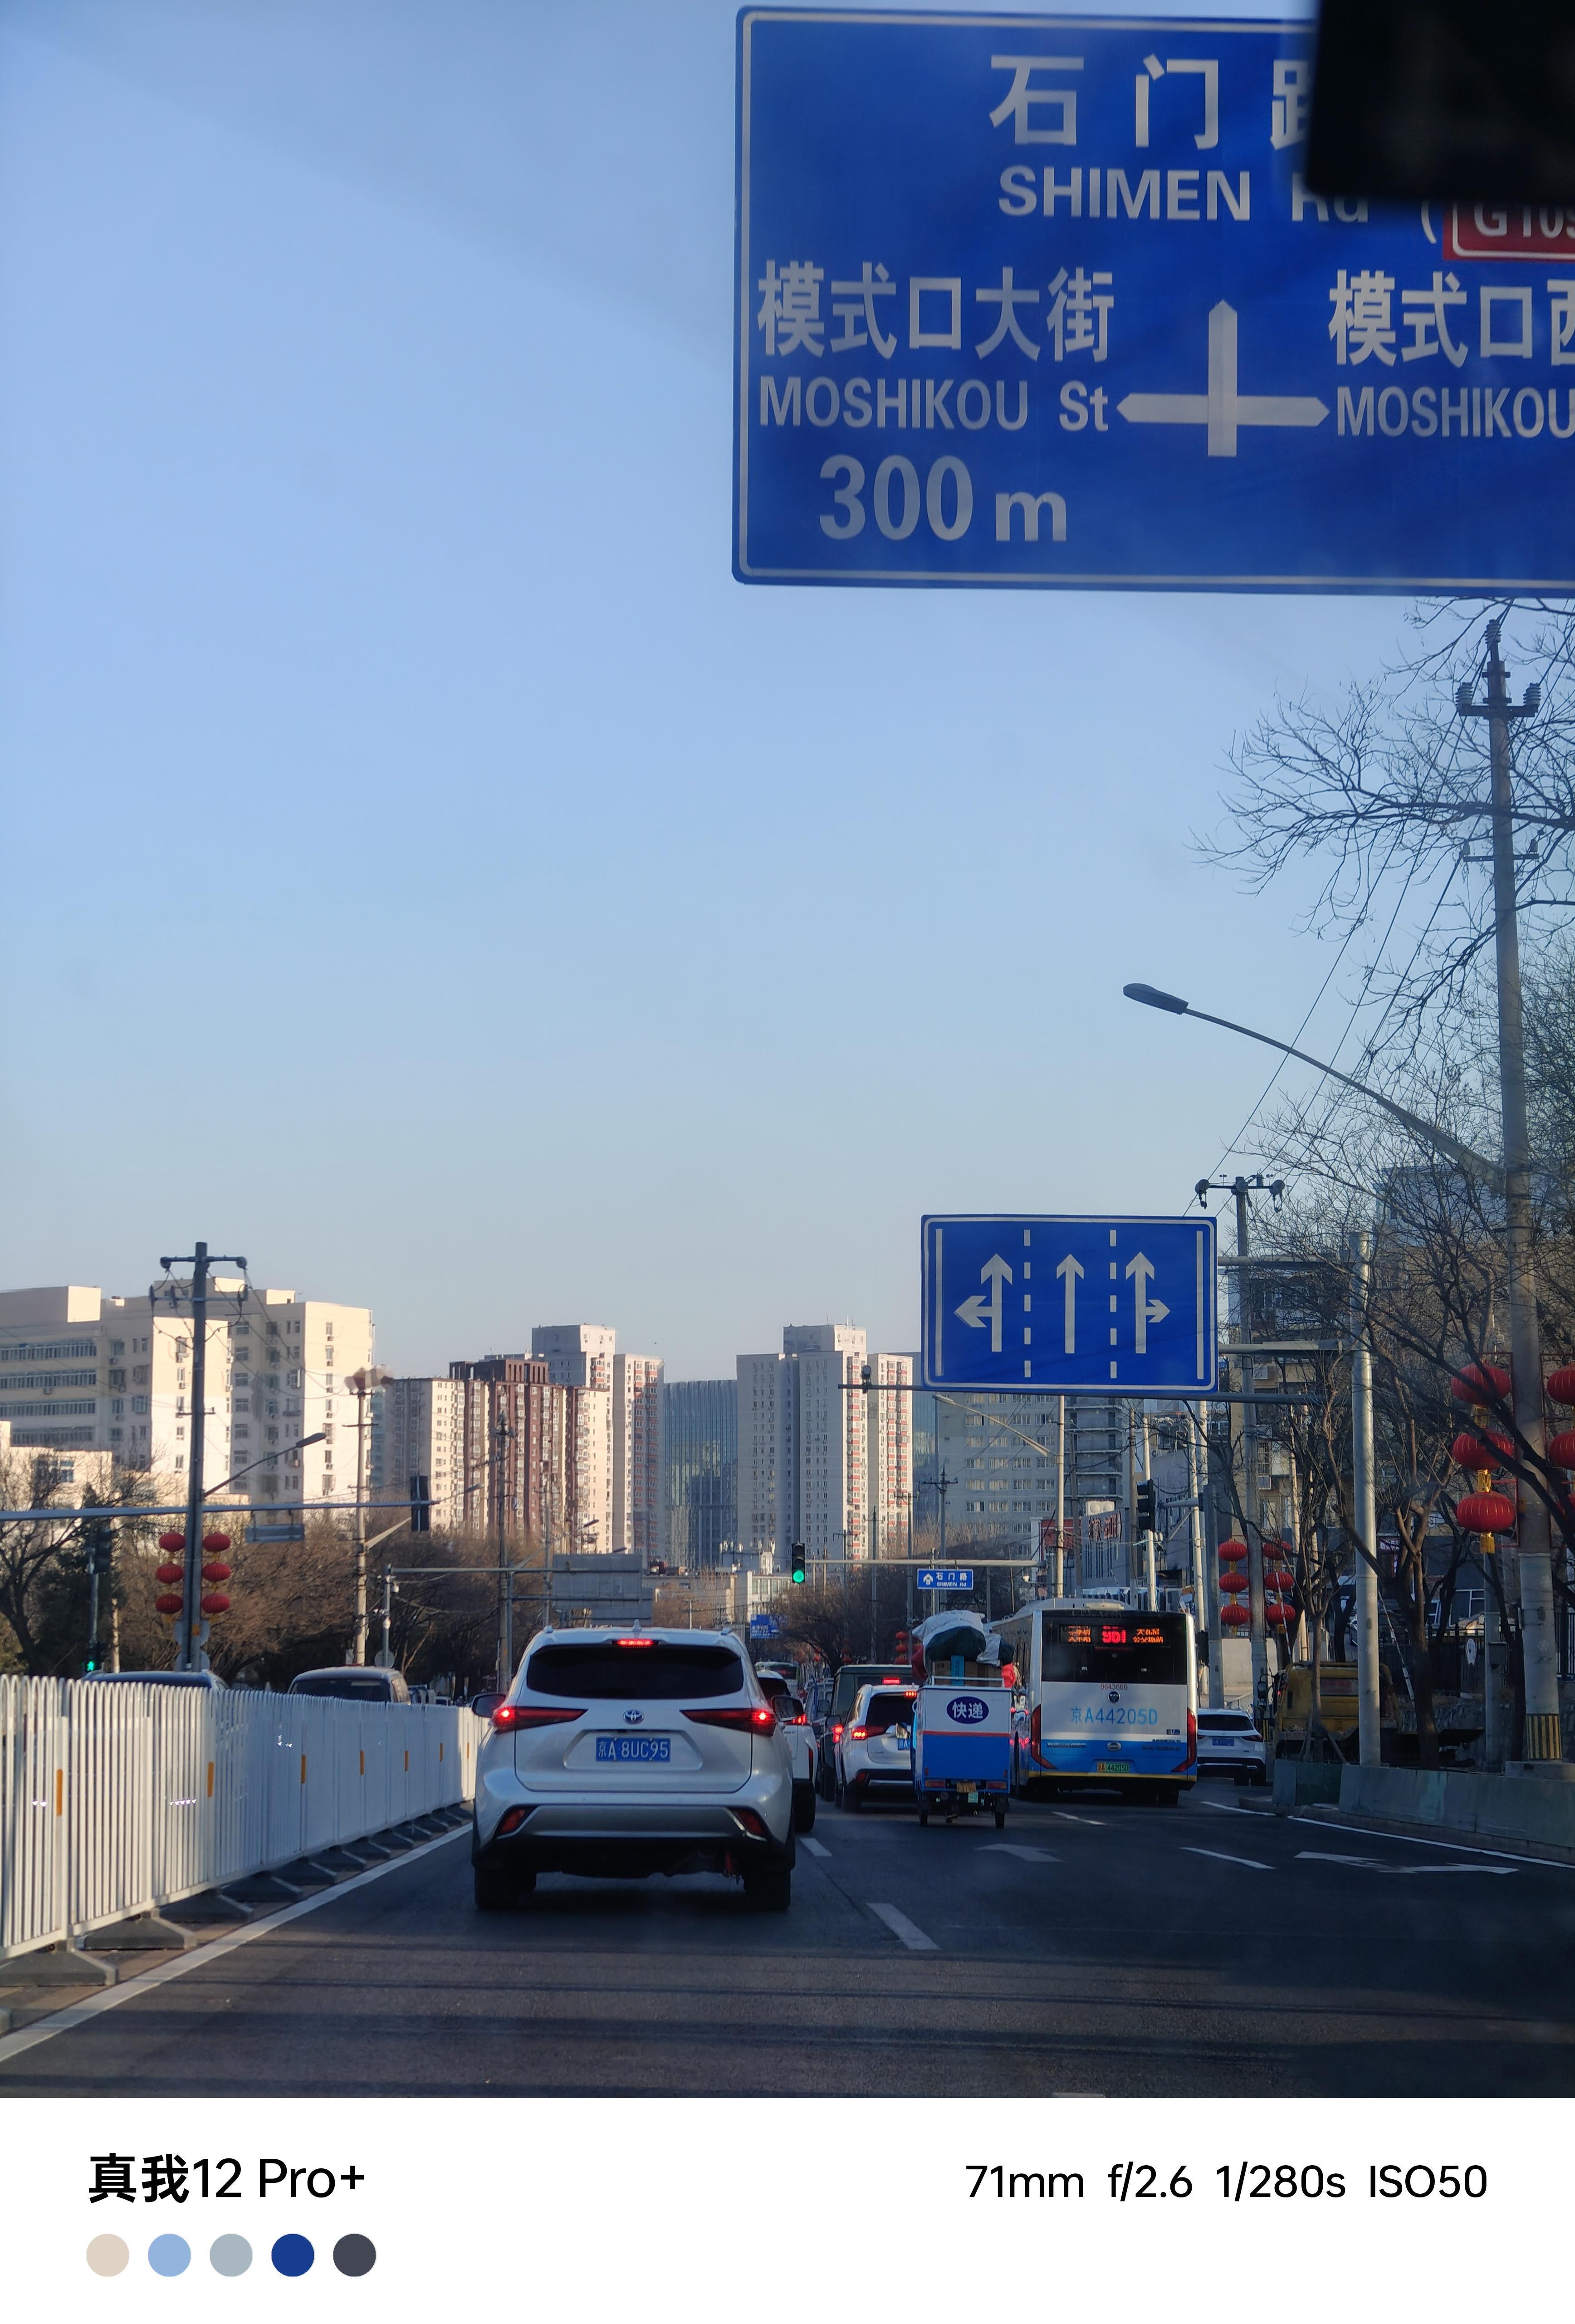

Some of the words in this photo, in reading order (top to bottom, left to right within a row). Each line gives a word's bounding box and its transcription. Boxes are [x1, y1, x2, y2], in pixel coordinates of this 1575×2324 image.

[999, 168, 1250, 221] SHIMEN
[758, 260, 1114, 362] 模式口大街
[760, 376, 1028, 430] MOSHIKOU
[1059, 382, 1109, 431] St
[1337, 386, 1575, 438] MOSHIKOU
[819, 456, 973, 540] 300
[996, 490, 1066, 541] m
[936, 1572, 967, 1581] 石门路
[952, 1701, 983, 1719] 快递
[1071, 1707, 1158, 1725] 京A44205D
